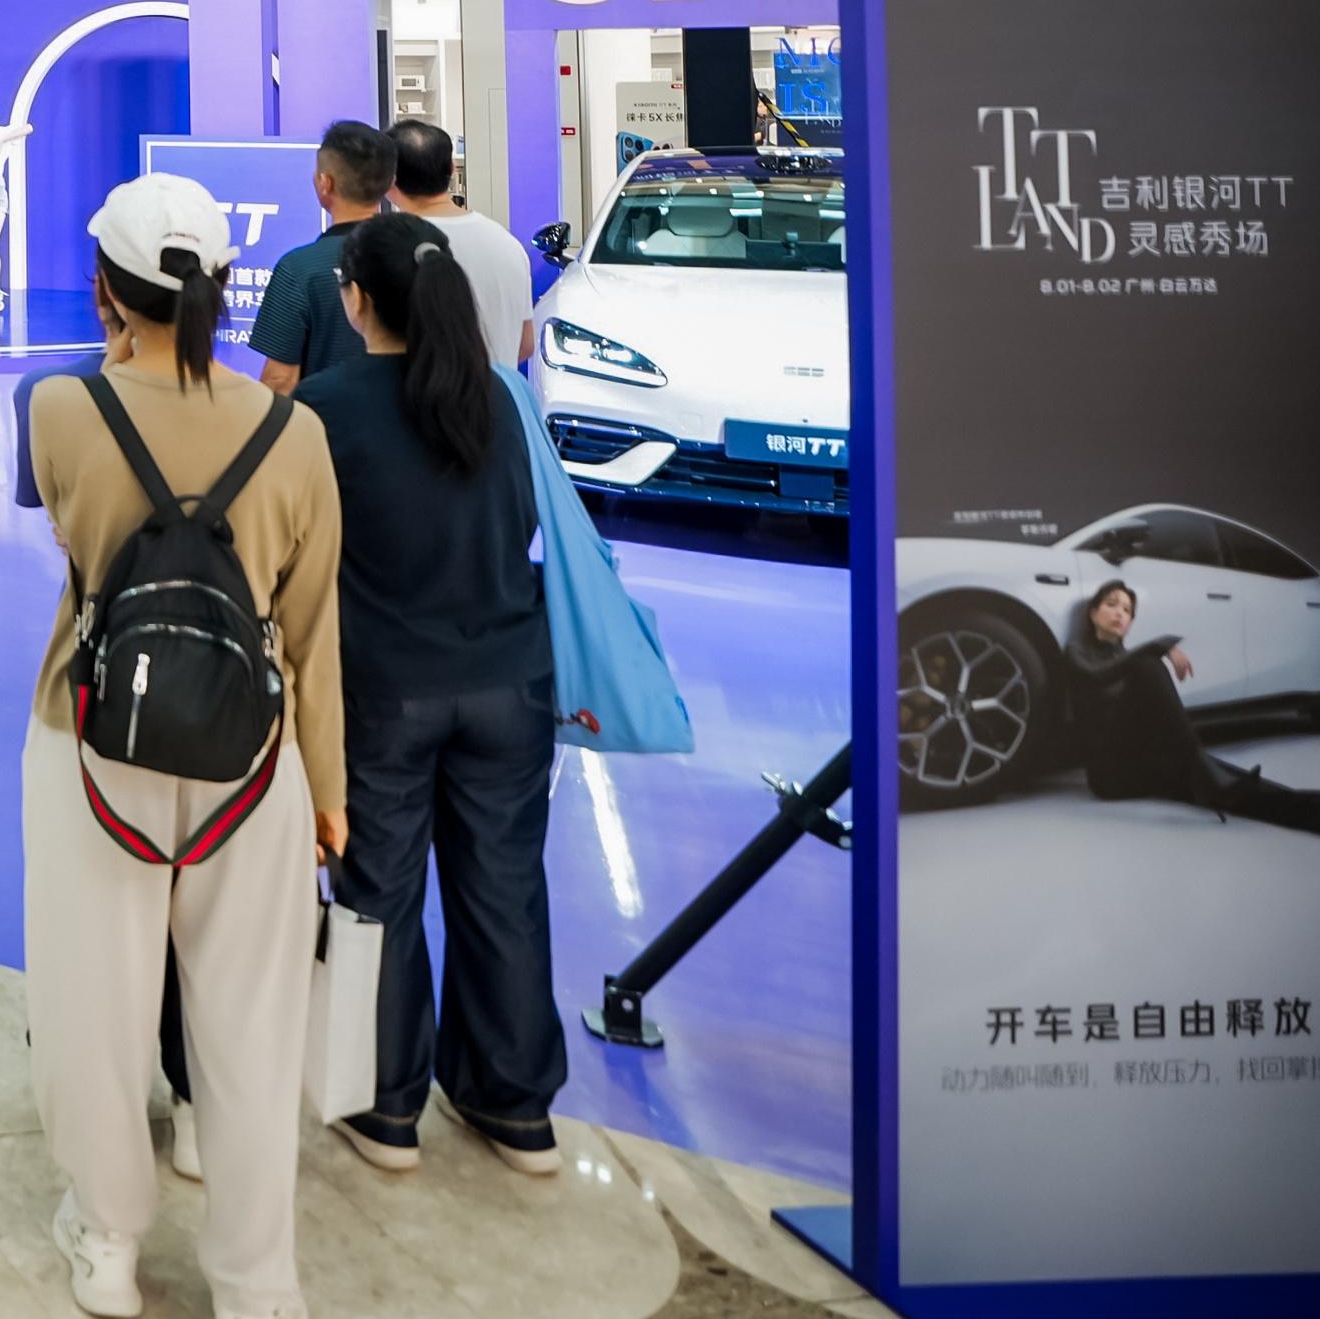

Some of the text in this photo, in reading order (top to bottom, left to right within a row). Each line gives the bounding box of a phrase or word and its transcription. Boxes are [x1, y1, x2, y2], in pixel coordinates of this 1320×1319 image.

[648, 112, 663, 122] 5X
[1099, 175, 1295, 210] 吉利银河TT
[971, 164, 1117, 264] LAND
[1127, 220, 1270, 257] 灵感秀场
[766, 433, 846, 457] 银河TT
[985, 997, 1312, 1046] 开车是自由释放
